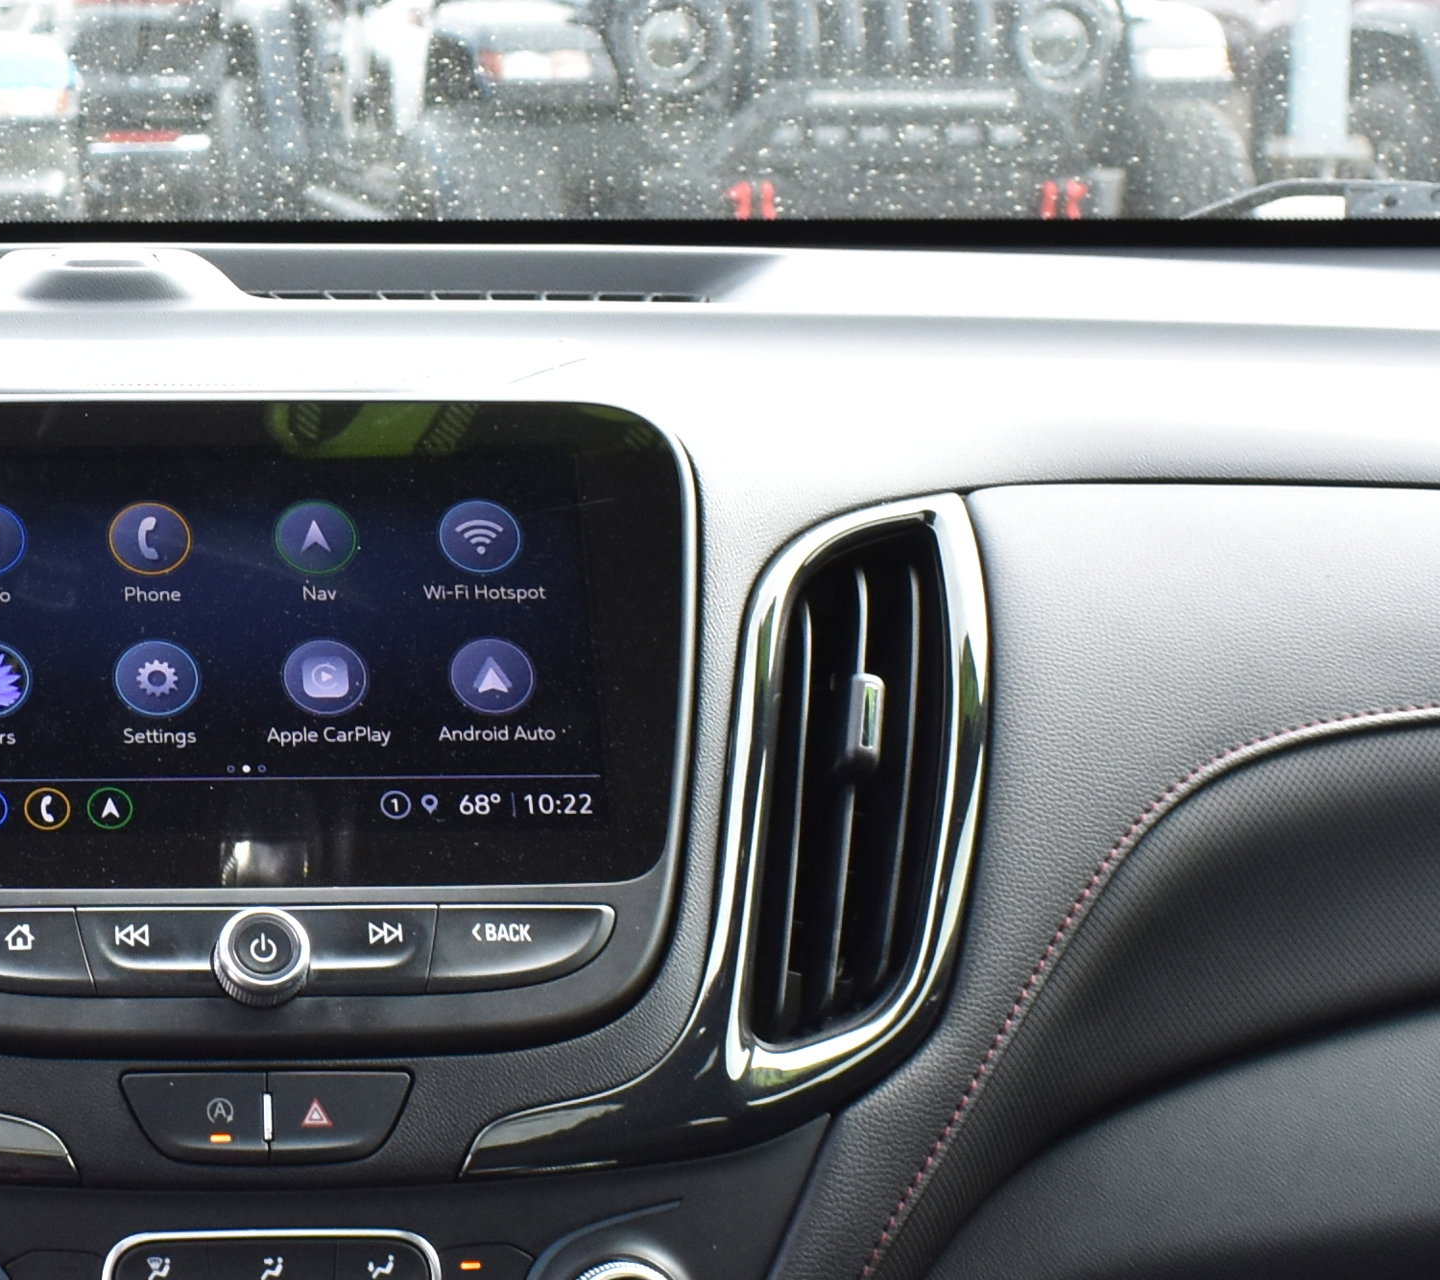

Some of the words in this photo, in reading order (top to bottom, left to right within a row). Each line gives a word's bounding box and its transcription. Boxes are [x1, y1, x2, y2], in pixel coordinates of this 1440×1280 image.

[123, 586, 182, 603] Phone
[302, 586, 338, 602] Nav
[422, 584, 470, 601] Wi-Fi
[473, 584, 547, 605] Hotspot
[123, 727, 198, 749] Settings
[266, 726, 320, 747] Apple
[322, 726, 392, 747] CarPlay
[438, 725, 509, 743] Android
[513, 725, 557, 742] Auto
[458, 792, 502, 816] 68°
[523, 793, 594, 815] 10:22
